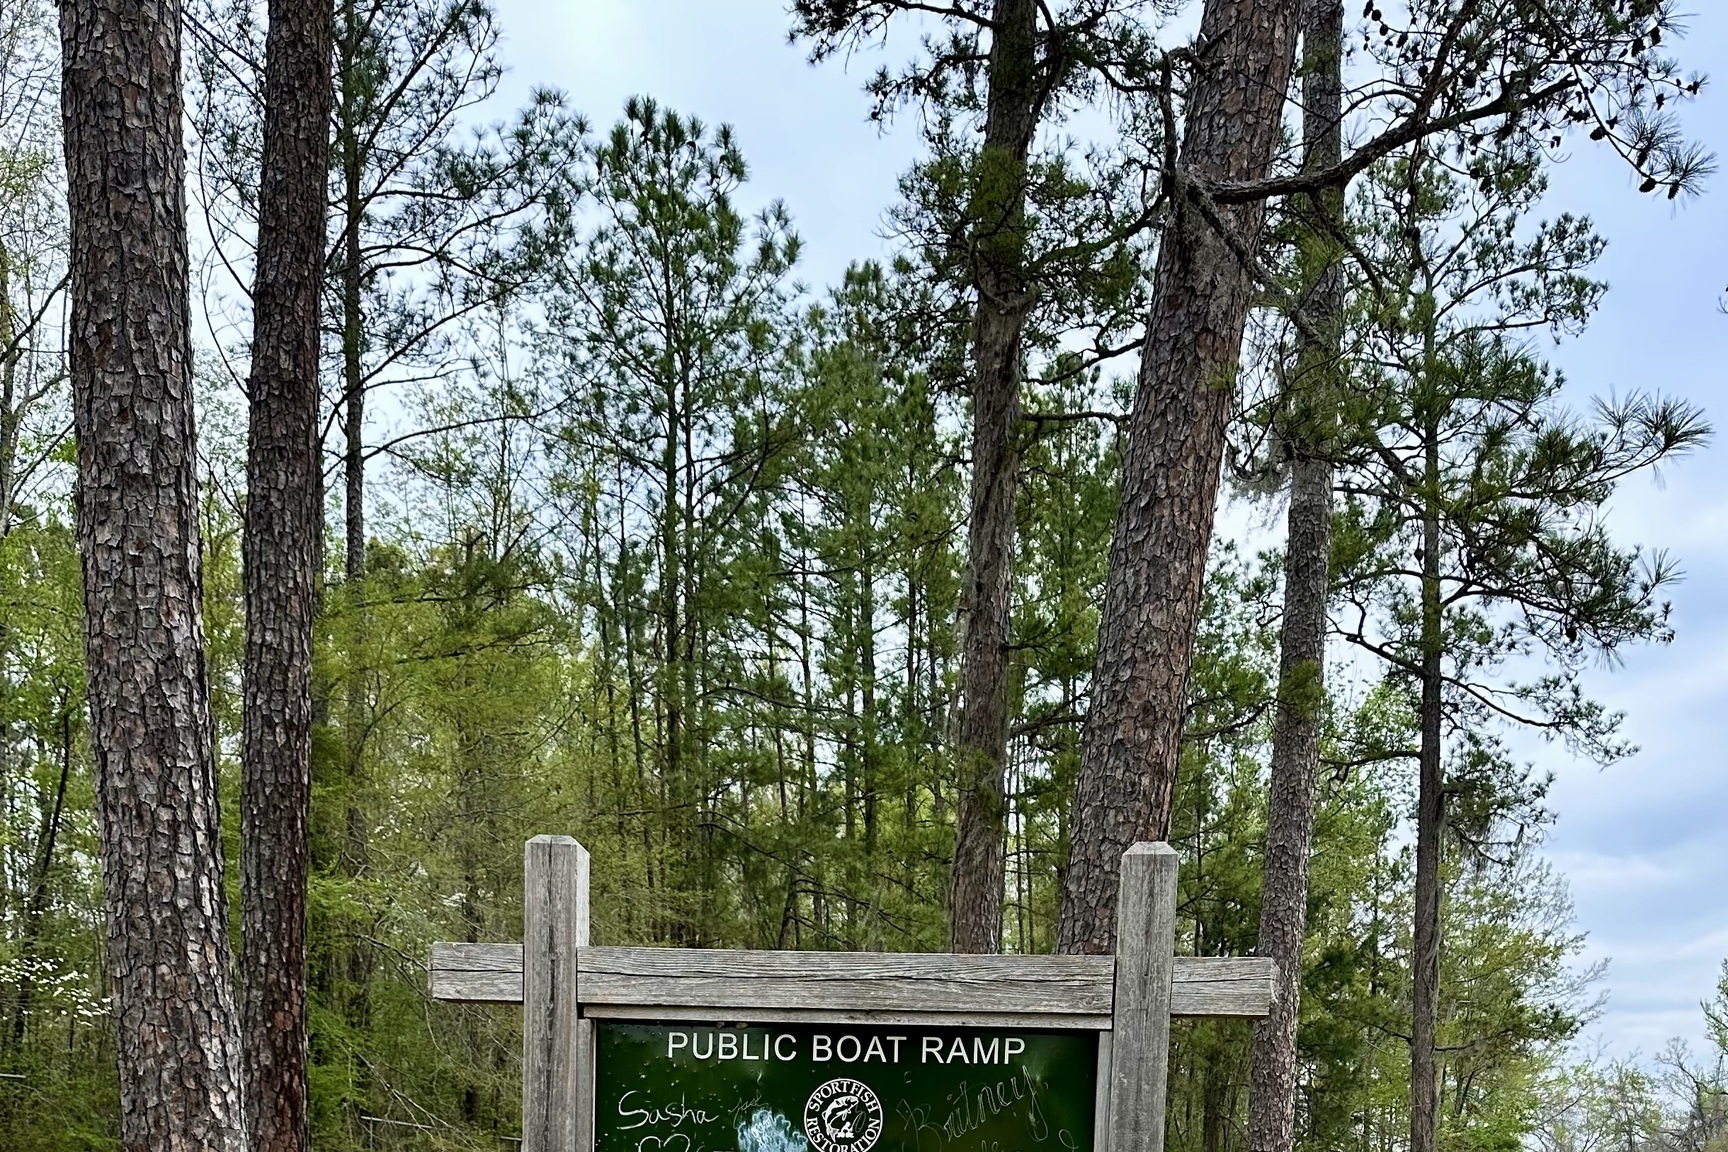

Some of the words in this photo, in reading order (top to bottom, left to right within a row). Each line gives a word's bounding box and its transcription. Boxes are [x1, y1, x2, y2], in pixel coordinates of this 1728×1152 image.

[667, 1032, 797, 1061] PUBLIC
[812, 1035, 907, 1063] BOAT
[921, 1037, 1025, 1065] RAMP
[617, 1091, 719, 1130] Sasha
